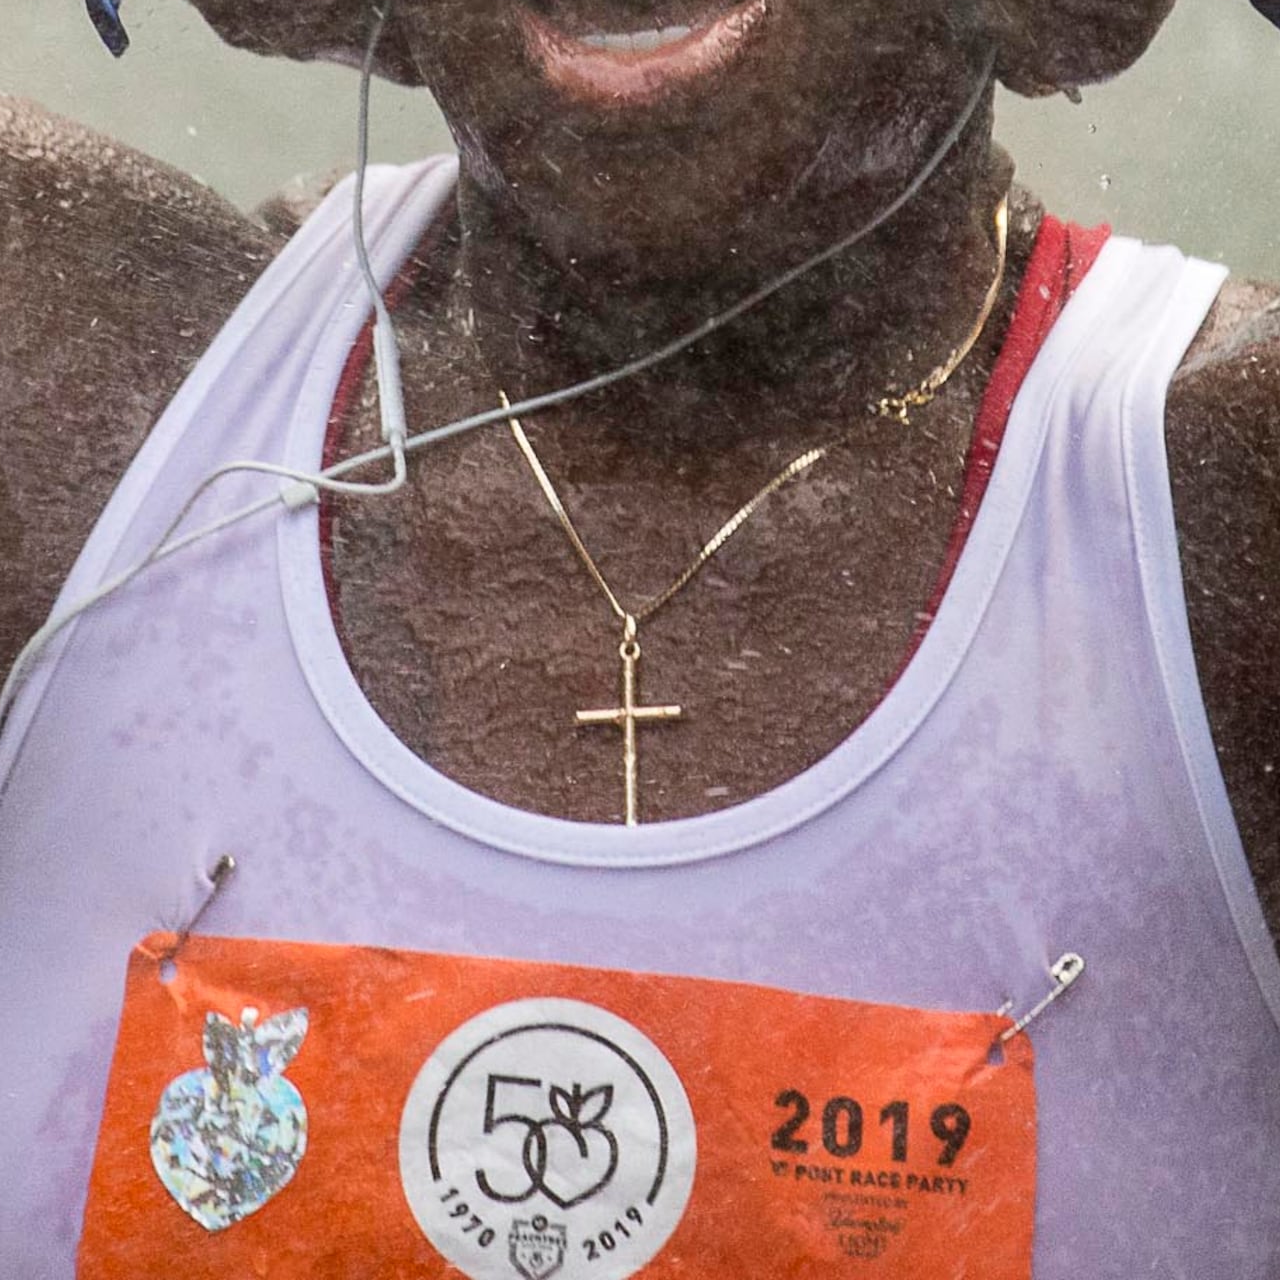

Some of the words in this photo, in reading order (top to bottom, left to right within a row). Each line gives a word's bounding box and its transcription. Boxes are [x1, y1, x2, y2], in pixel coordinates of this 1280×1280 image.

[771, 1089, 971, 1167] 2019
[850, 1170, 901, 1189] RACE
[907, 1175, 969, 1195] PARTY
[440, 1188, 496, 1248] 1970
[583, 1206, 644, 1261] 2019
